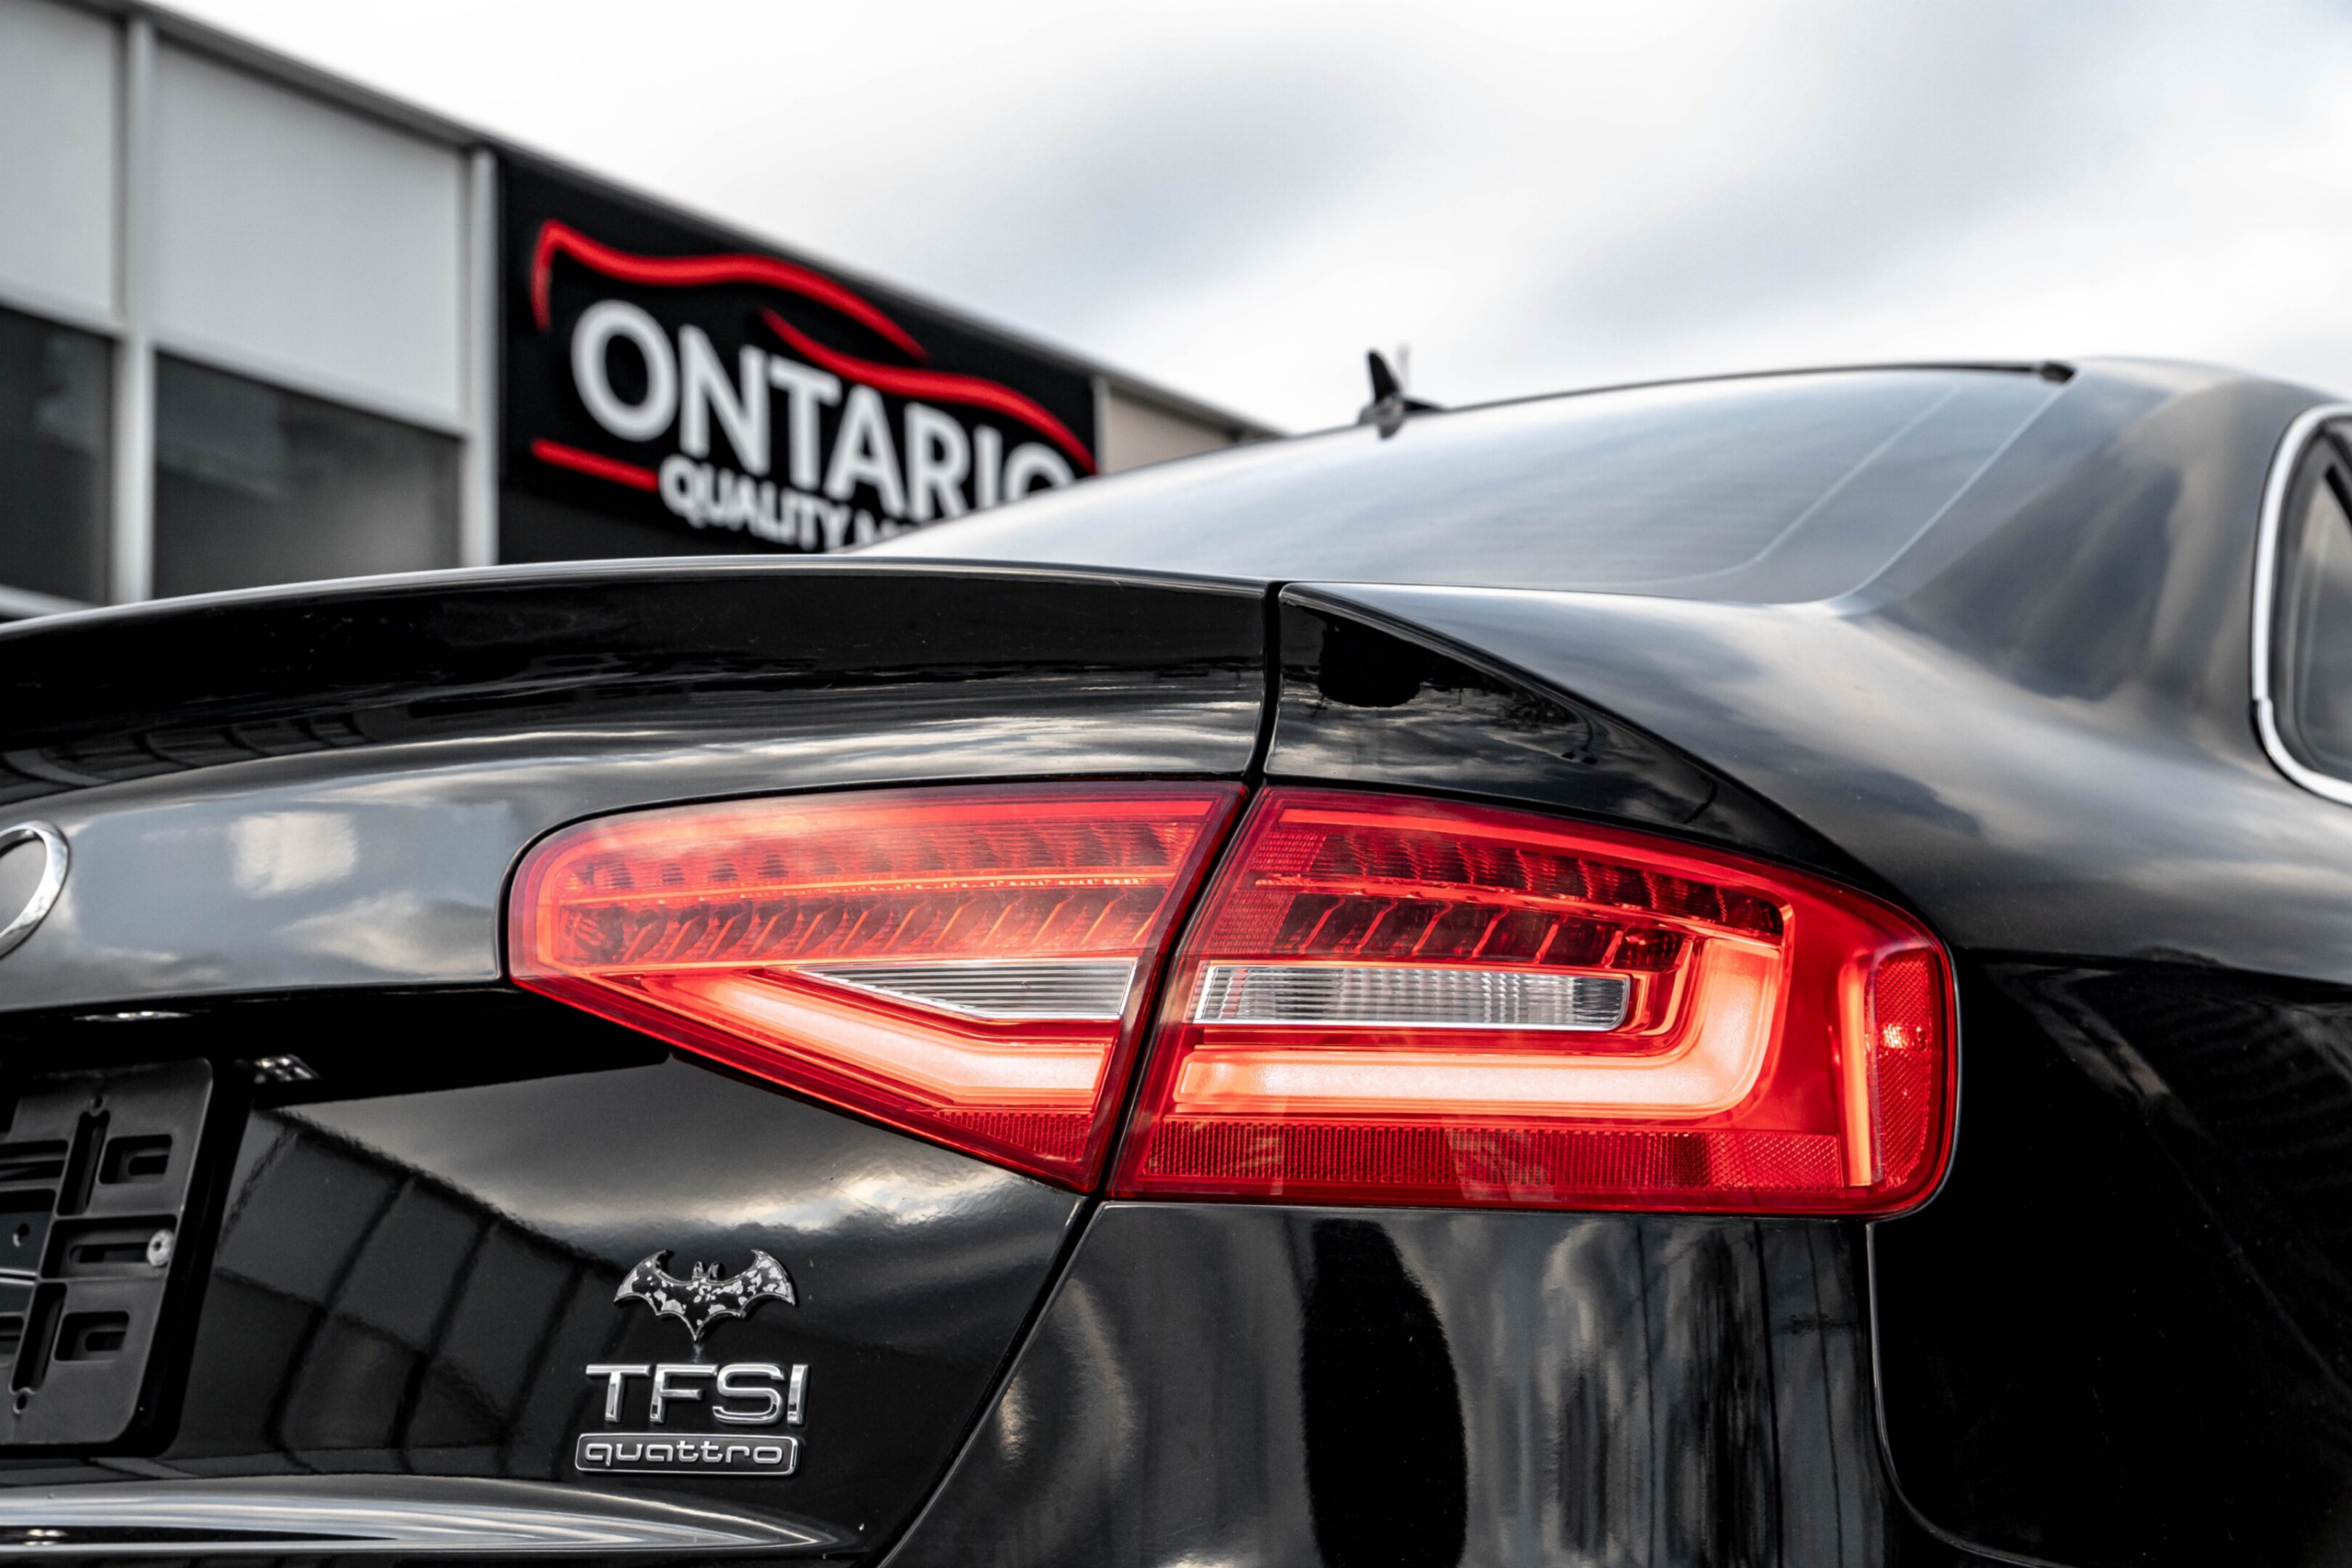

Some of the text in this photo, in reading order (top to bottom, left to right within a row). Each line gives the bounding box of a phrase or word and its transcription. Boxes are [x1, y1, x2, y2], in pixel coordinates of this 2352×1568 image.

[658, 453, 852, 553] QUALITY
[585, 1363, 809, 1426] TFSI
[584, 1440, 784, 1467] quattro
